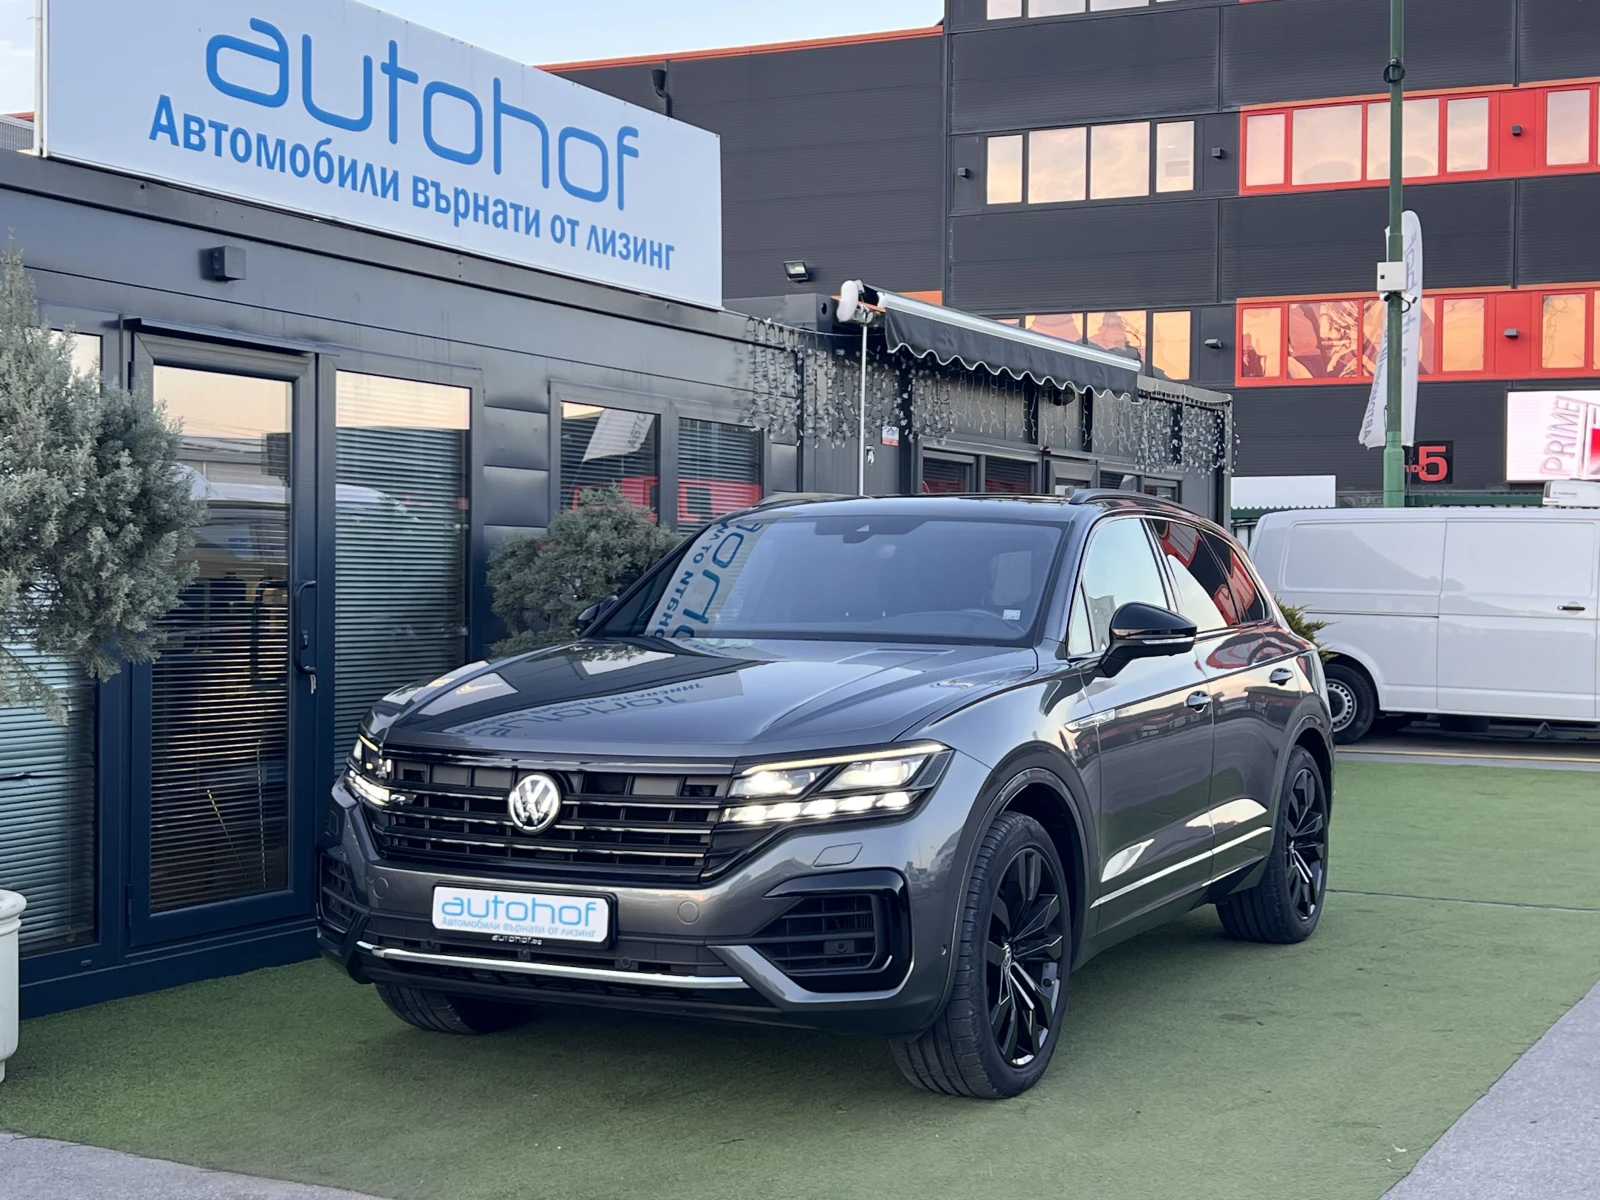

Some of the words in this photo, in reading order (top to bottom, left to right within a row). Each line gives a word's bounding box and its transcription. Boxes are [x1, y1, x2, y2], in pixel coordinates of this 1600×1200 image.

[205, 16, 640, 211] autohof
[148, 94, 400, 203] Автомобили
[412, 178, 541, 240] върнати
[549, 214, 580, 248] от
[586, 217, 676, 271] лизинг
[1418, 445, 1448, 481] 5
[1540, 400, 1580, 476] PRIME
[441, 894, 597, 927] autohof
[441, 916, 500, 931] Автомобили
[503, 922, 545, 935] върнати
[547, 926, 559, 936] от
[560, 928, 597, 938] лизинг
